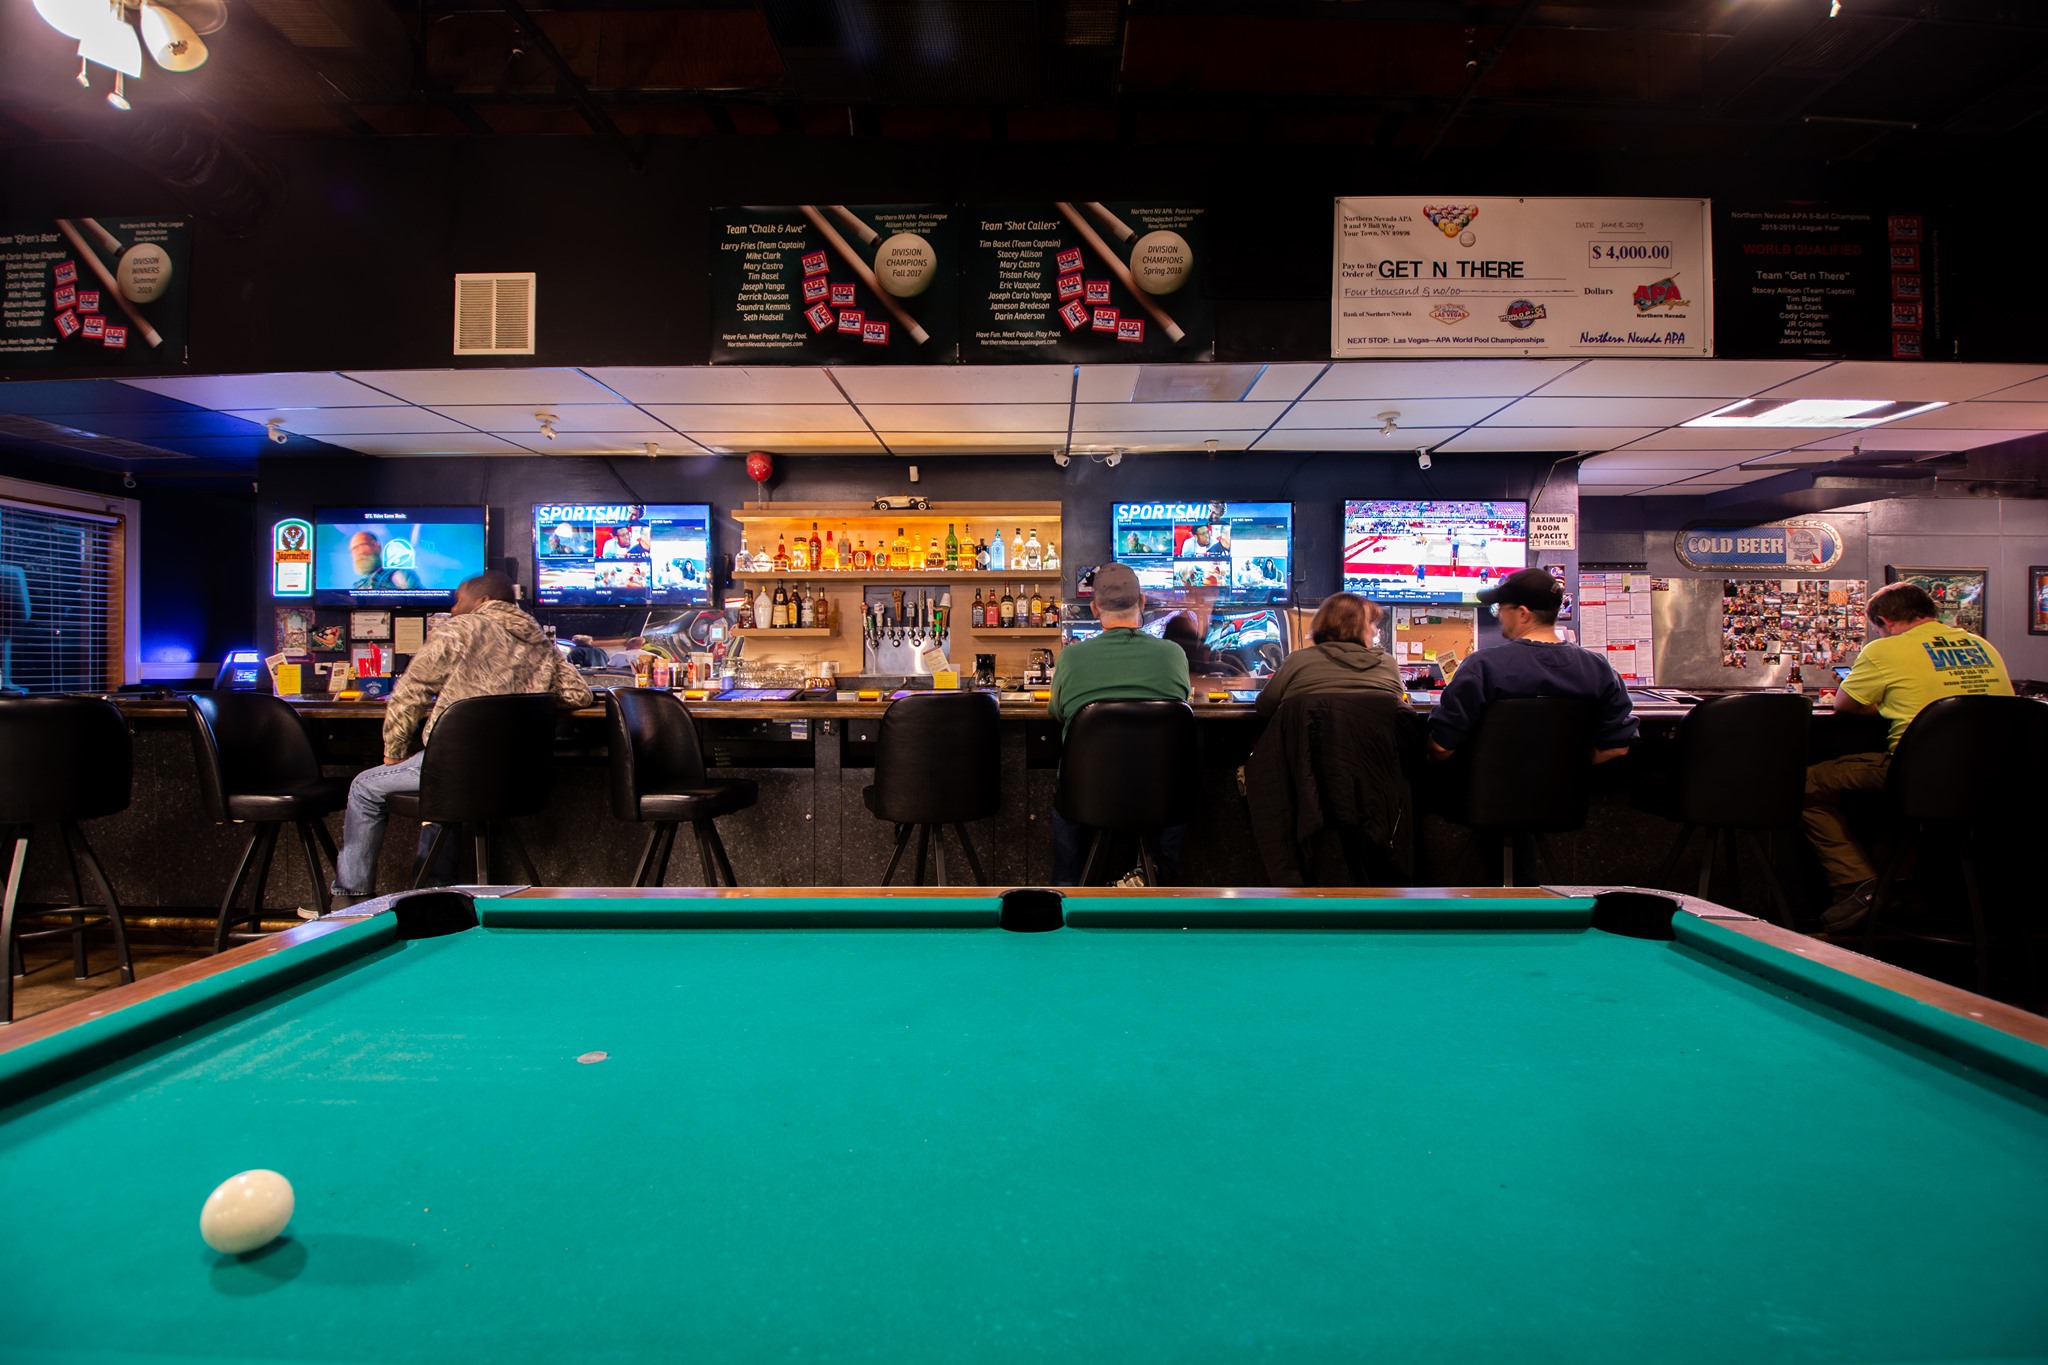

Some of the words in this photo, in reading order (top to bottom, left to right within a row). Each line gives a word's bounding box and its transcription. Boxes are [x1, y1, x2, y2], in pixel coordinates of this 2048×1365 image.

[726, 225, 747, 234] Team
[749, 224, 776, 234] "Chalk
[778, 224, 784, 233] &
[785, 224, 806, 233] Awe"
[981, 221, 1003, 230] Team
[1004, 221, 1026, 230] "Shot
[1027, 221, 1060, 230] Callers"
[721, 243, 739, 251] Larry
[740, 242, 756, 250] Fries
[757, 241, 776, 250] (Team
[778, 241, 805, 251] Captain)
[979, 240, 992, 248] Tim
[993, 240, 1011, 248] Basel
[1012, 240, 1032, 248] (Team
[1033, 240, 1061, 248] Captain)
[997, 250, 1019, 259] Stacey
[1020, 250, 1043, 258] Allison
[1592, 245, 1602, 260] $
[1606, 246, 1669, 261] 4,000.00
[1743, 244, 1791, 255] WORLD
[1794, 244, 1862, 256] QUALIFIED
[746, 252, 762, 260] Mike
[763, 252, 781, 260] Clark
[1142, 256, 1184, 264] CHAMPIONS
[743, 262, 760, 271] Mary
[762, 262, 784, 270] Castro
[1000, 261, 1017, 270] Mary
[1018, 260, 1040, 268] Castro
[1379, 260, 1423, 278] GET
[1433, 261, 1447, 277] N
[1456, 261, 1524, 278] THERE
[761, 272, 779, 280] Basel
[1023, 271, 1041, 280] Foley
[1144, 267, 1165, 276] Spring
[1756, 271, 1782, 279] Team
[1785, 271, 1807, 280] "Get
[1818, 271, 1850, 280] There"
[742, 283, 763, 291] Joseph
[765, 283, 785, 291] Yanga
[1000, 281, 1013, 289] Eric
[1014, 282, 1040, 290] Vazquez
[988, 292, 1011, 300] Joseph
[1031, 292, 1052, 300] Yanga
[1344, 288, 1367, 297] Four
[1371, 287, 1419, 296] thousand
[1422, 287, 1430, 297] &
[1634, 285, 1682, 300] APA
[736, 303, 764, 311] Saundra
[765, 303, 791, 311] Kemmis
[990, 302, 1019, 310] Jameson
[744, 313, 758, 321] Seth
[759, 313, 784, 321] Hadsell
[994, 312, 1013, 320] Darin
[1014, 312, 1045, 320] Anderson
[1580, 332, 1625, 343] Northern
[1627, 332, 1662, 344] Nevada
[1664, 332, 1685, 344] APA
[1687, 537, 1733, 554] COLD
[1737, 537, 1784, 554] BEER
